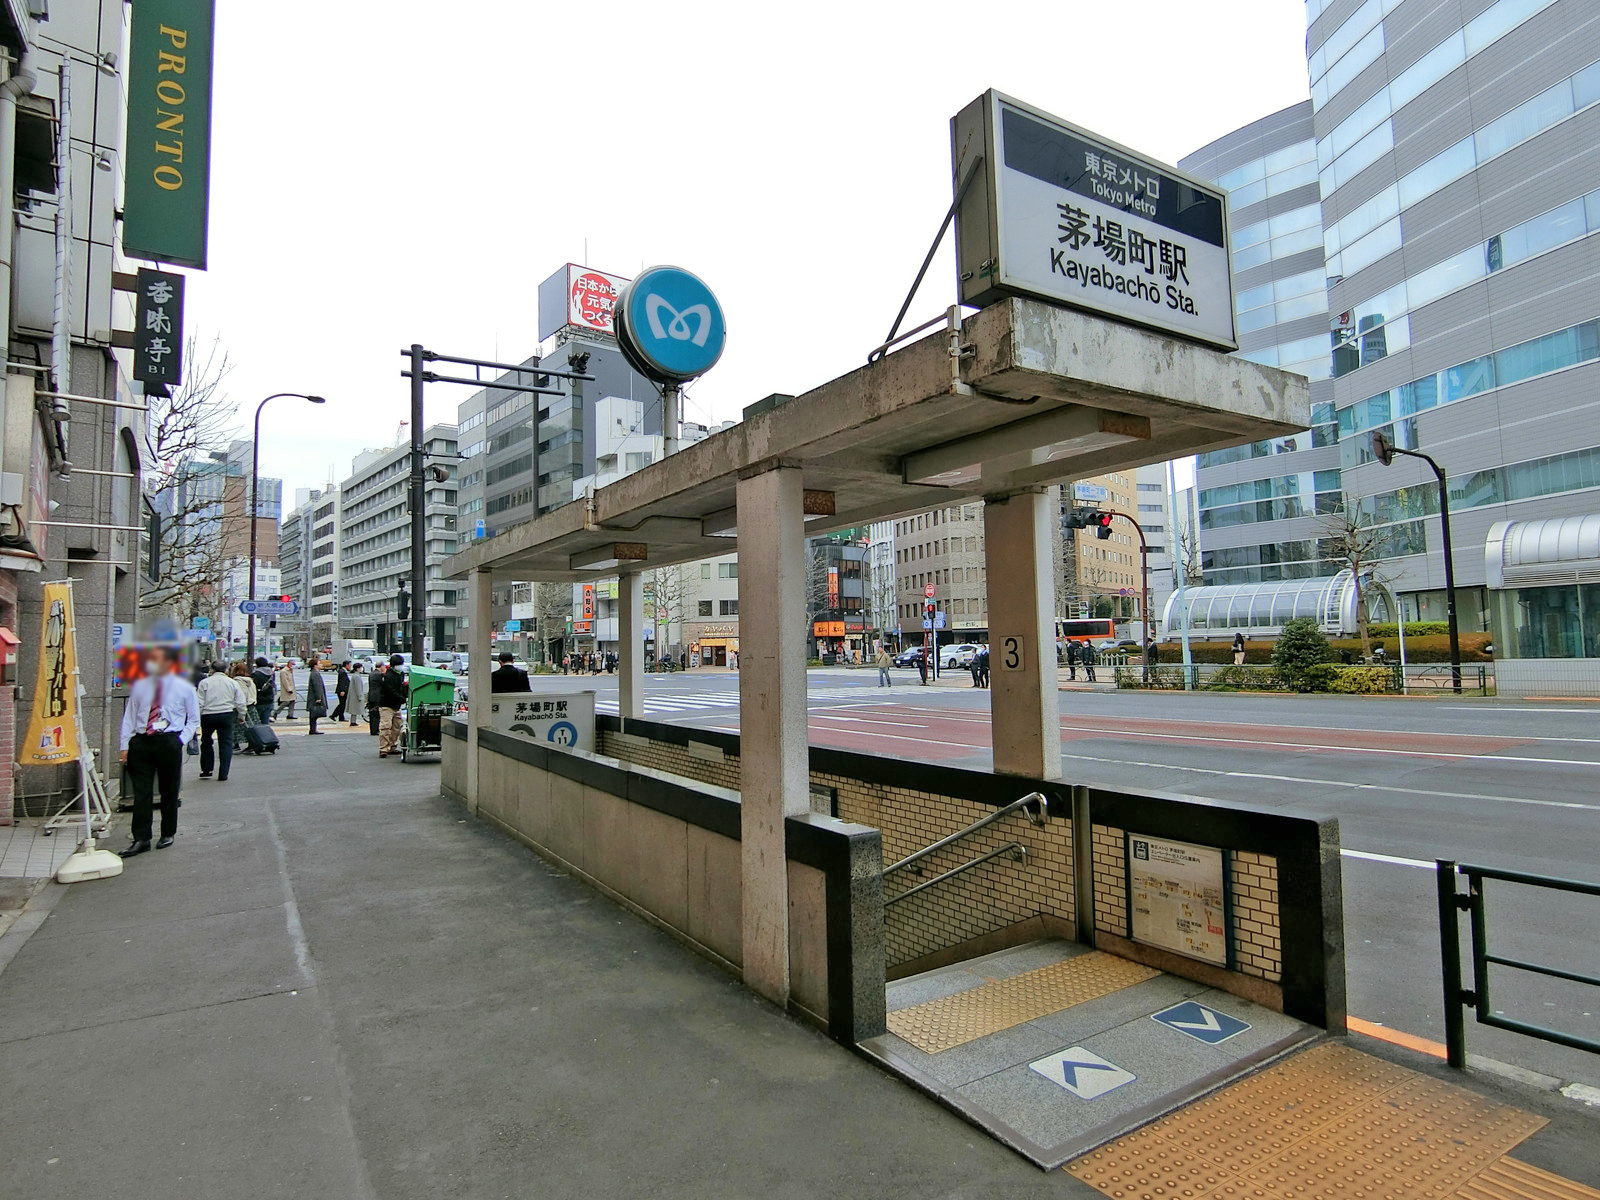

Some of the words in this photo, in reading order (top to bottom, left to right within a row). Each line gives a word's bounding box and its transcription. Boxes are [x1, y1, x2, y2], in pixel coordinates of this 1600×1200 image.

[153, 23, 188, 191] PRONTO
[1084, 151, 1160, 200] 東京メトロ
[1090, 178, 1123, 204] Tokyo
[1125, 195, 1157, 217] Metro
[1056, 202, 1190, 286] 茅場町駅
[577, 277, 618, 297] 日本から
[1166, 284, 1199, 316] Sta.
[144, 280, 173, 363] 香味亭
[584, 310, 612, 325] つくる
[148, 365, 166, 375] B1
[1004, 637, 1020, 669] 3
[492, 704, 500, 712] 3
[516, 701, 568, 714] 茅場町駅
[555, 711, 568, 719] Sta.
[558, 736, 567, 744] 11
[560, 729, 566, 737] T
